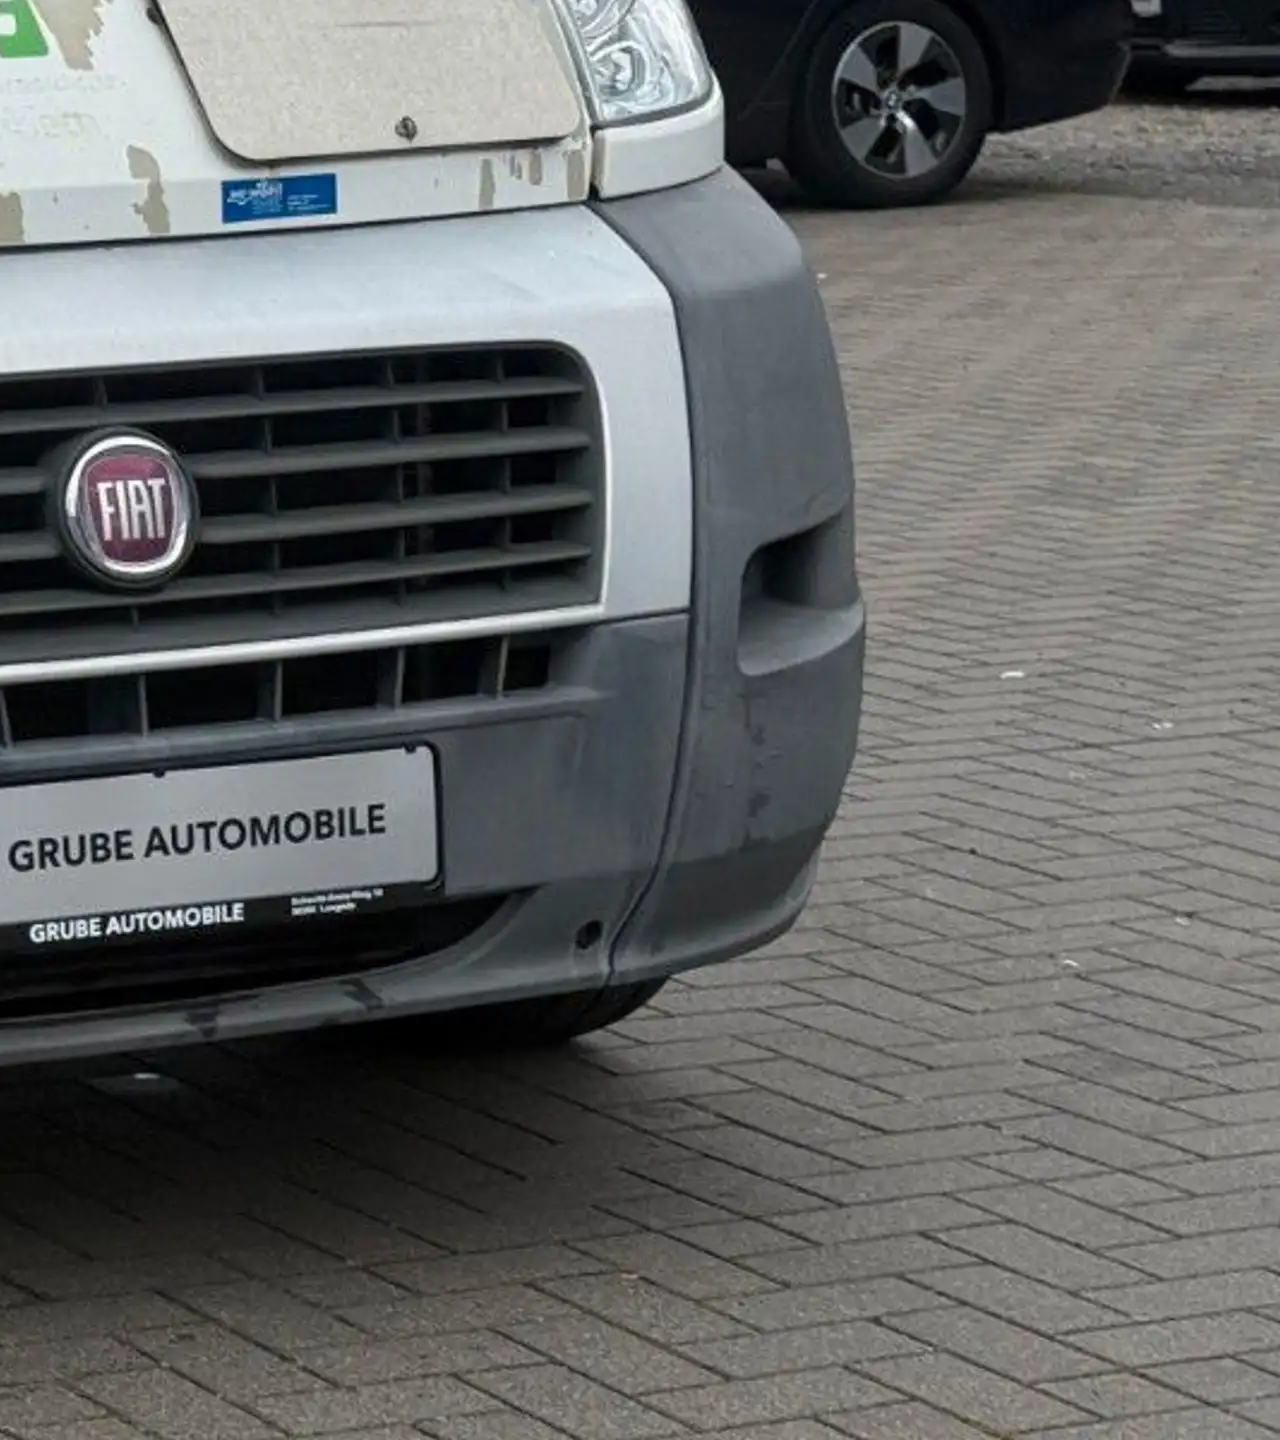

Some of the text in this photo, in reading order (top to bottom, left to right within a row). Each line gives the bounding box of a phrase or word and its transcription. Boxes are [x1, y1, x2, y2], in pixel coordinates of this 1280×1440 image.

[96, 477, 167, 542] FIAT
[7, 803, 387, 872] GRUBE AUTOMOBILE
[28, 901, 245, 944] GRUBE AUTOMOBILE
